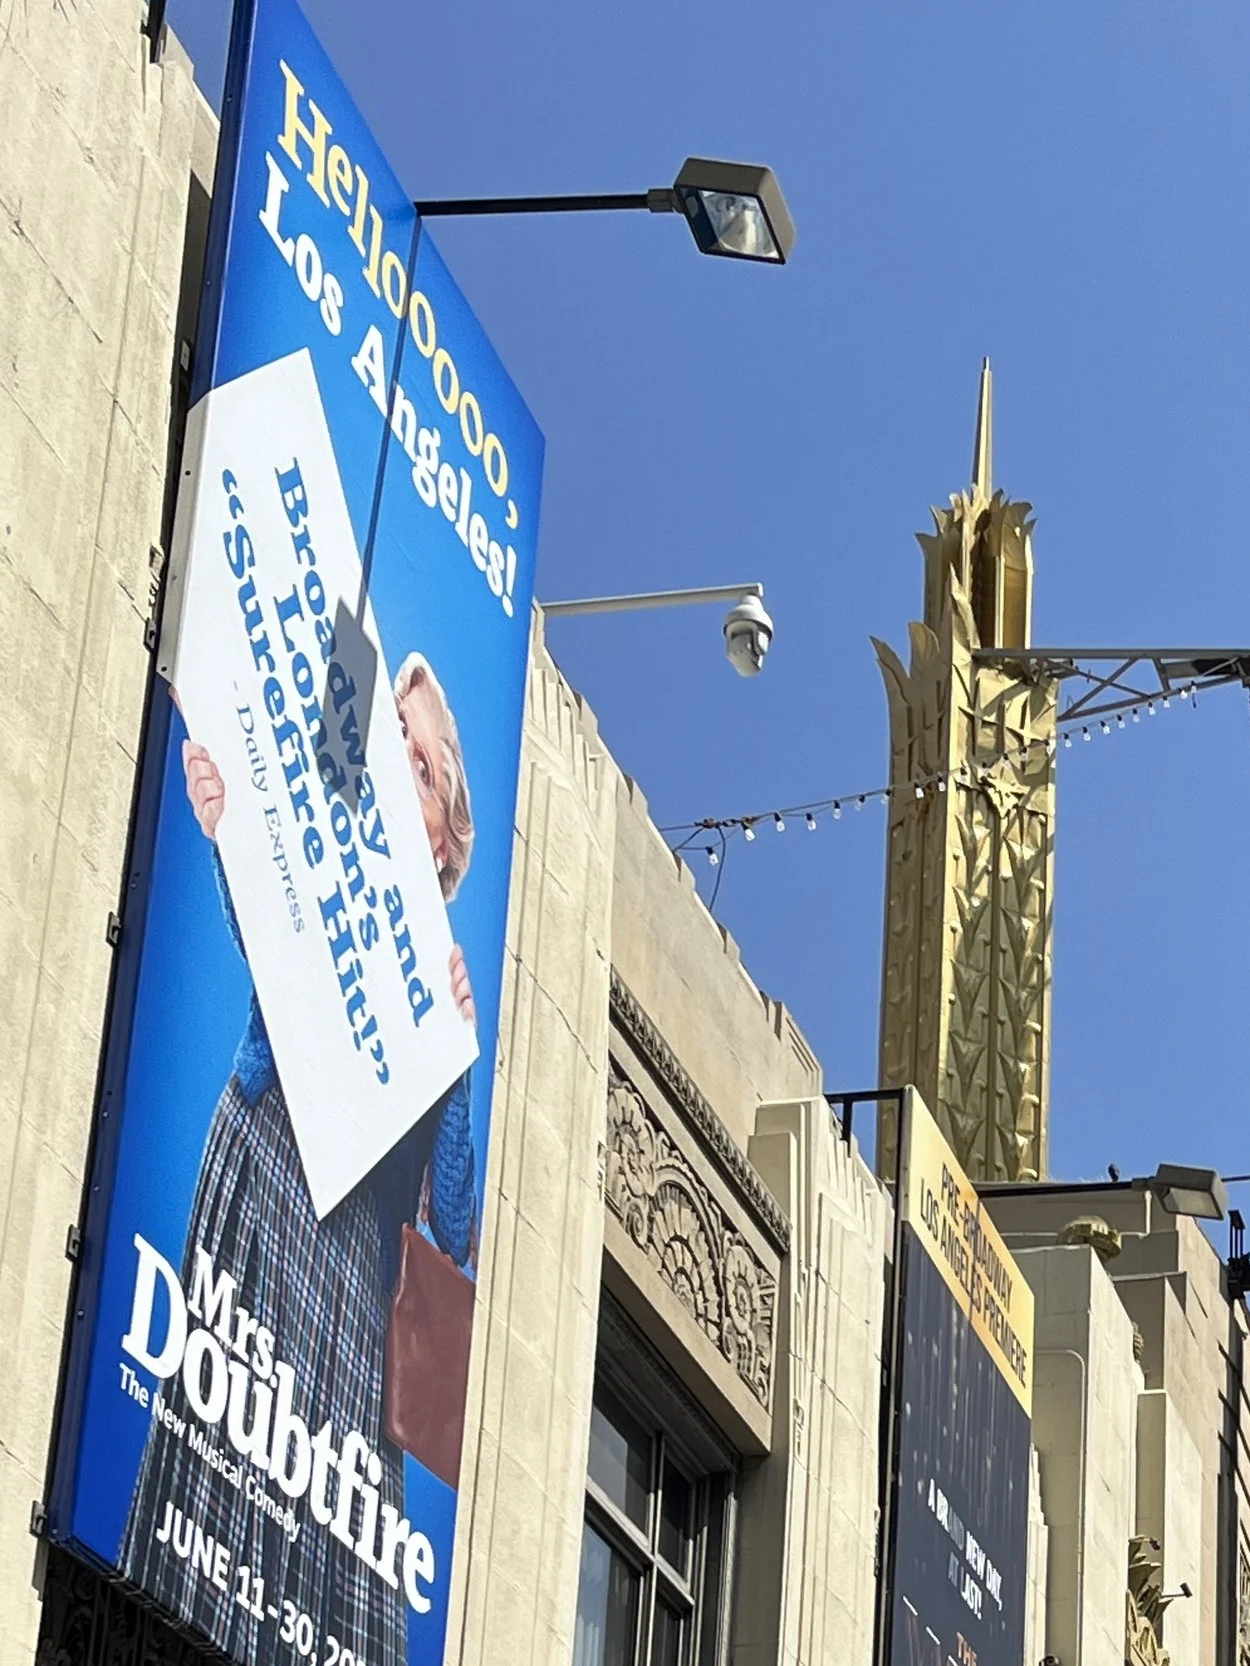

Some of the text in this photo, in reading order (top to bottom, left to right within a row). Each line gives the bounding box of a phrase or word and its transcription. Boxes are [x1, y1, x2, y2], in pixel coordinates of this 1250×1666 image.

[259, 150, 517, 618] Los Angeles!
[222, 468, 390, 1085] "Surefire Hit!"
[236, 704, 268, 792] Daily
[263, 805, 306, 933] Express
[274, 584, 380, 952] London's
[275, 457, 434, 1027] Broadway and
[920, 1177, 1028, 1389] LOS ANGELES PREMIERE
[941, 1162, 1013, 1313] PRE-BROADWAY
[119, 1362, 301, 1544] The New Musical Comedy
[122, 1233, 435, 1614] Doubtfire
[928, 1478, 935, 1512] A
[936, 1488, 965, 1551] BRAND
[966, 1530, 985, 1580] NEW
[156, 1500, 231, 1592] JUNE
[948, 1551, 982, 1620] AT LAST!
